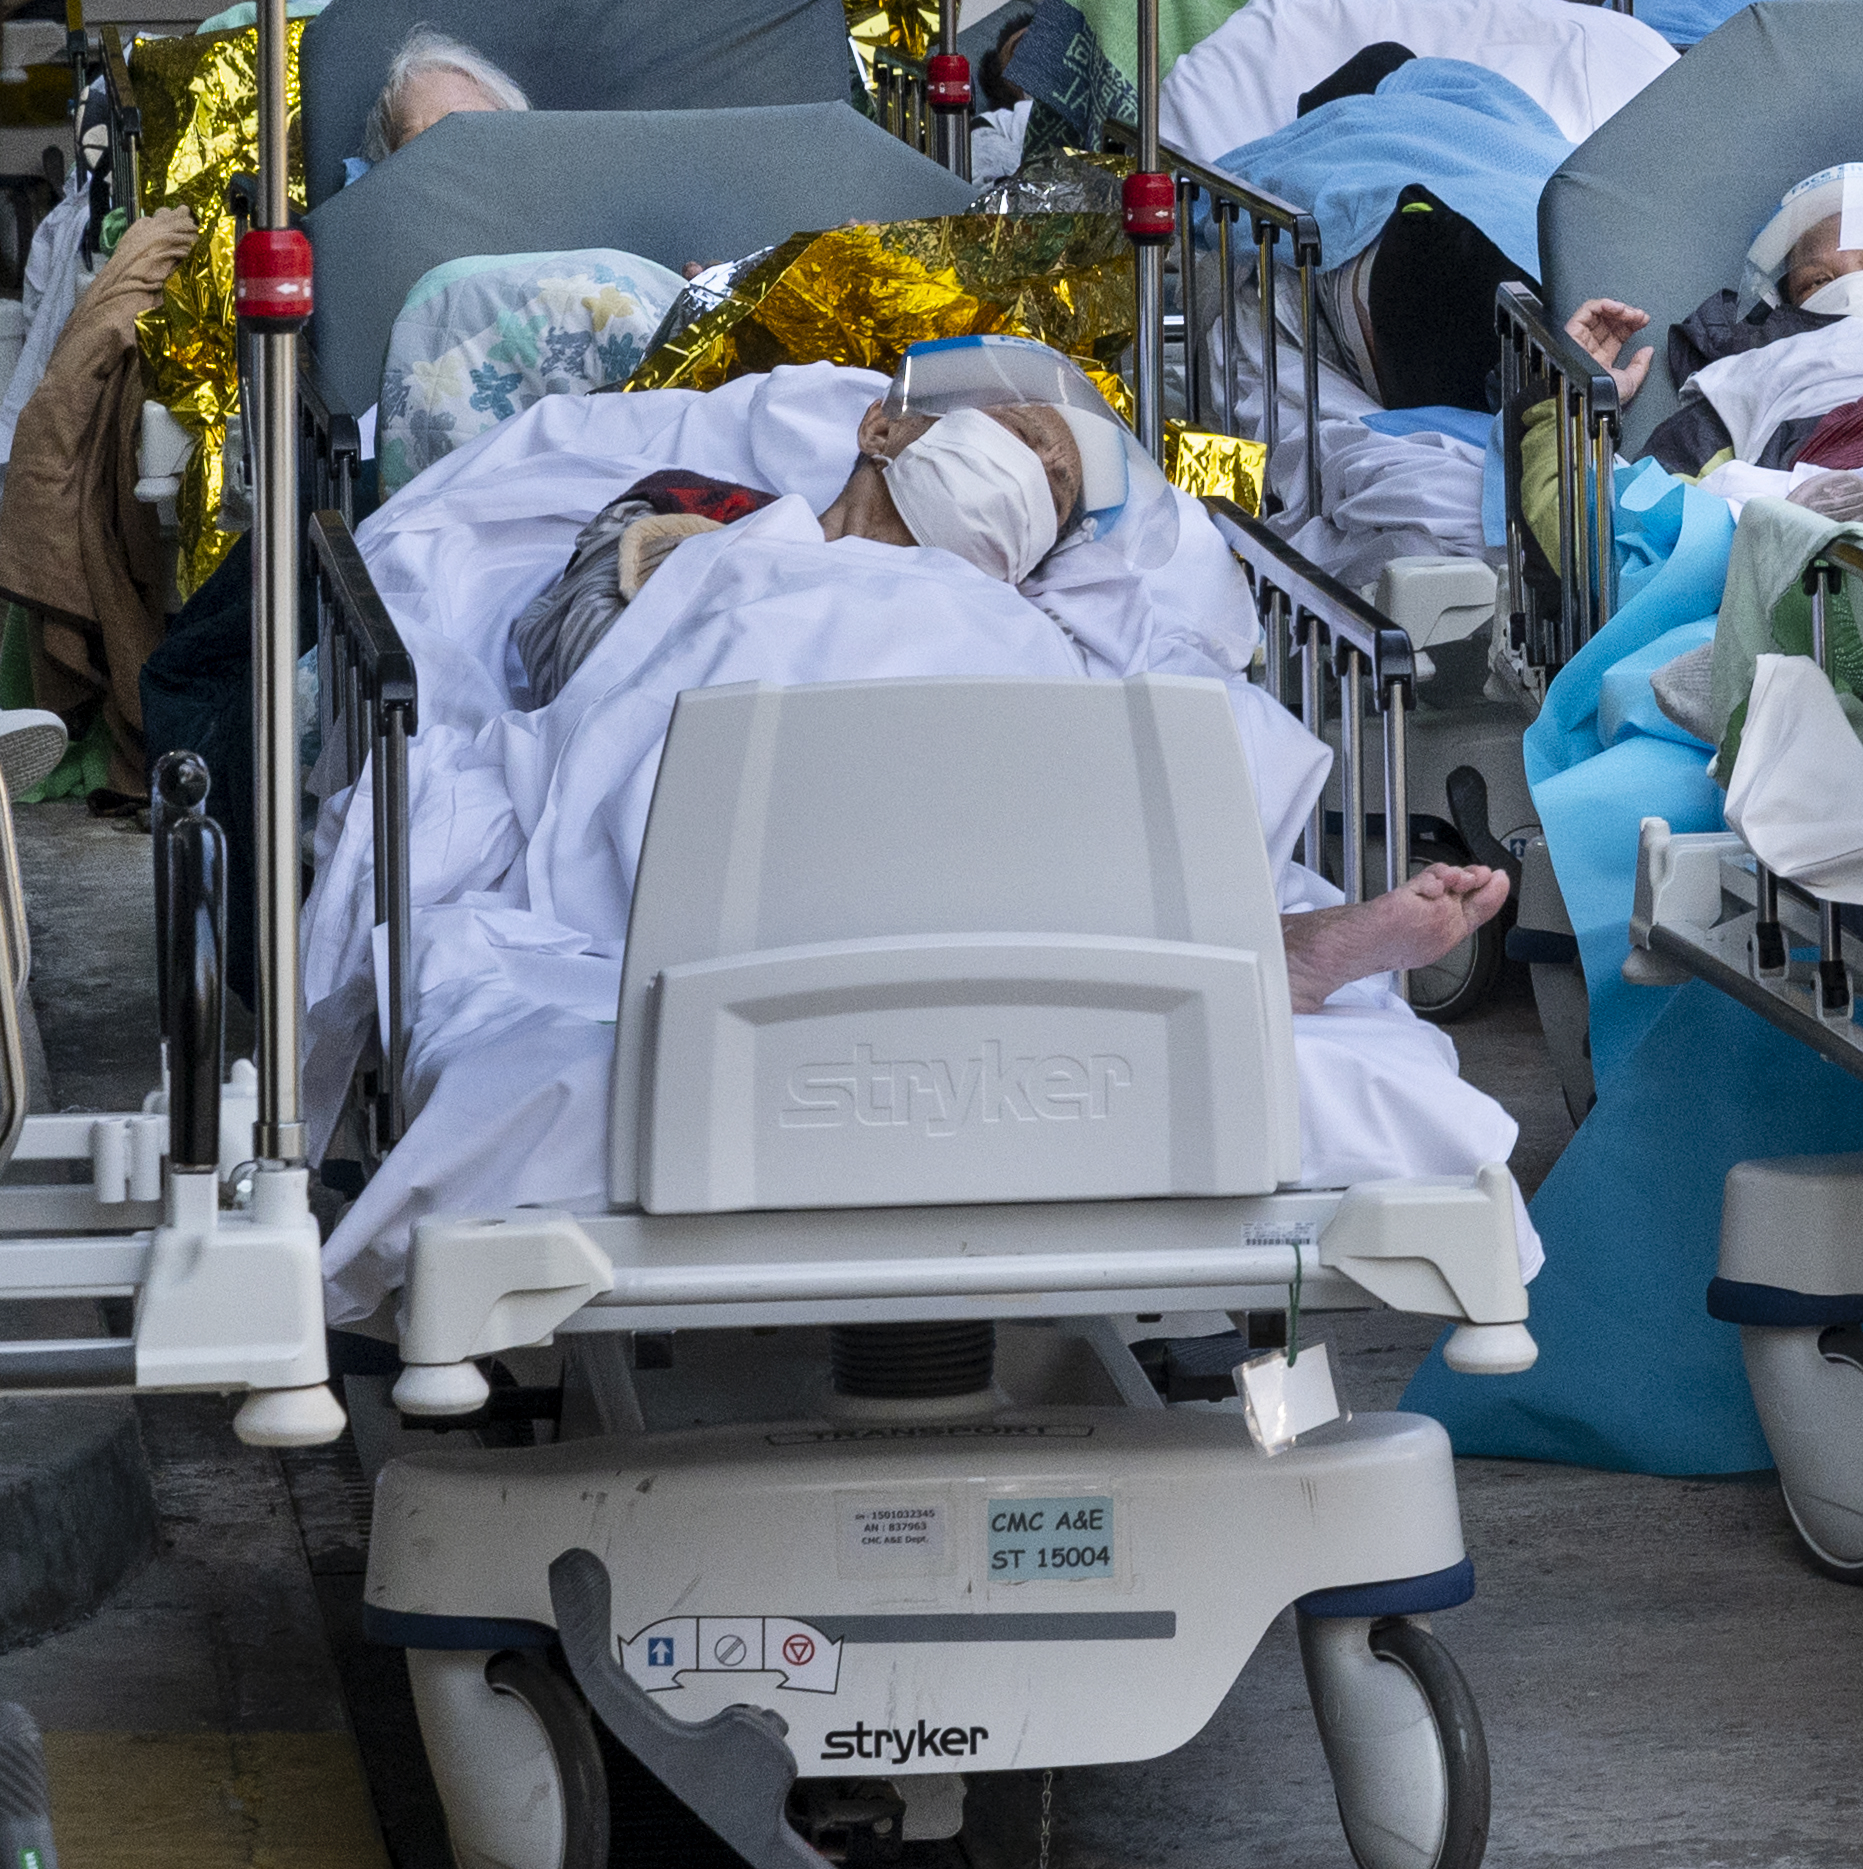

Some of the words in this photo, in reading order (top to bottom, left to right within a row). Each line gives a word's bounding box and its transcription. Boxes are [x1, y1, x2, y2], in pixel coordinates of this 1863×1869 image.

[780, 1039, 1134, 1137] stryker
[864, 1523, 879, 1532] AN
[889, 1521, 928, 1532] 837963
[871, 1509, 936, 1521] 1501032345
[991, 1510, 1044, 1534] CMC
[1055, 1508, 1104, 1531] A&E
[861, 1536, 882, 1545] CMC
[991, 1549, 1026, 1570] ST
[1037, 1545, 1111, 1569] 15004
[820, 1719, 990, 1765] stryker
